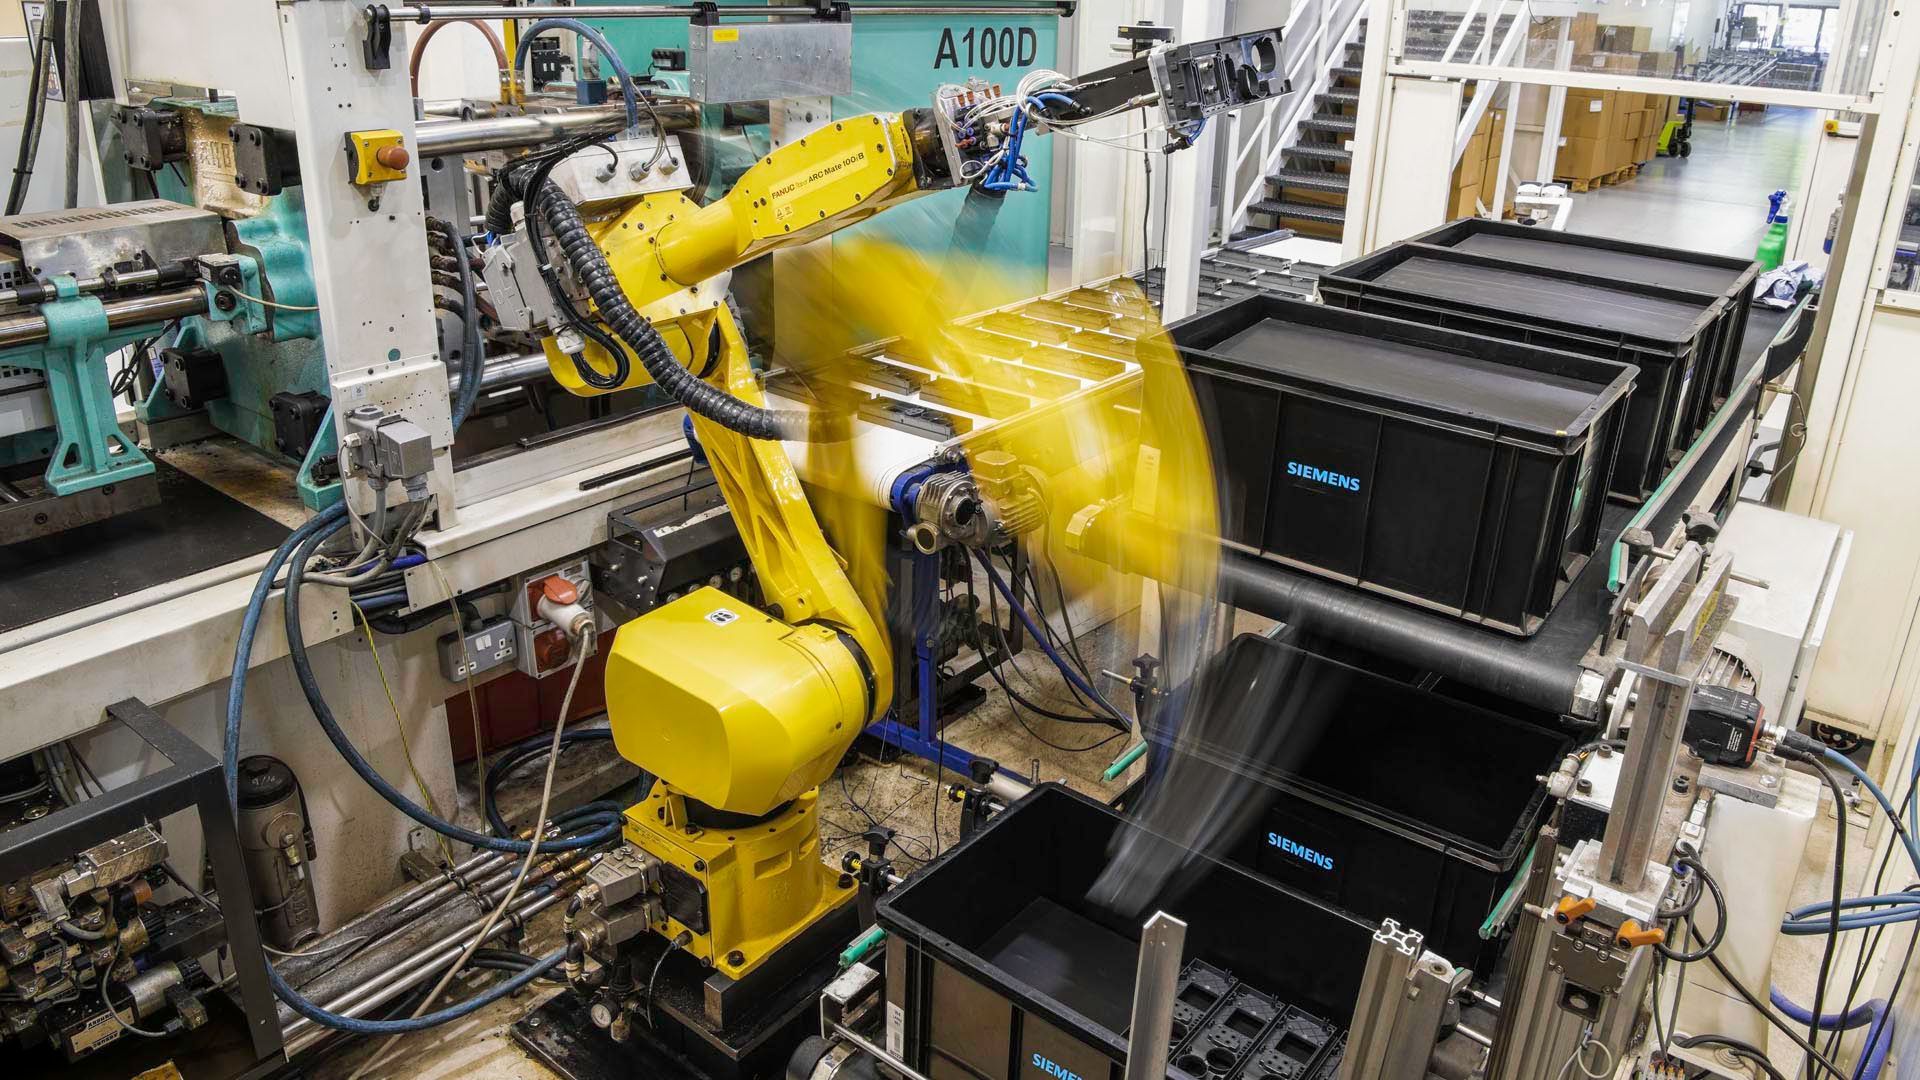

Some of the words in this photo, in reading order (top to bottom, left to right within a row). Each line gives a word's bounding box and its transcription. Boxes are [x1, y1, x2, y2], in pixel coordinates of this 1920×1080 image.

[933, 27, 1037, 69] A100D
[771, 184, 795, 199] FANUC
[808, 171, 824, 183] ARC
[824, 163, 842, 176] Mate
[1287, 461, 1361, 491] SIEMENS
[1268, 832, 1334, 870] SIEMENS
[1032, 1053, 1083, 1080] SIEME
